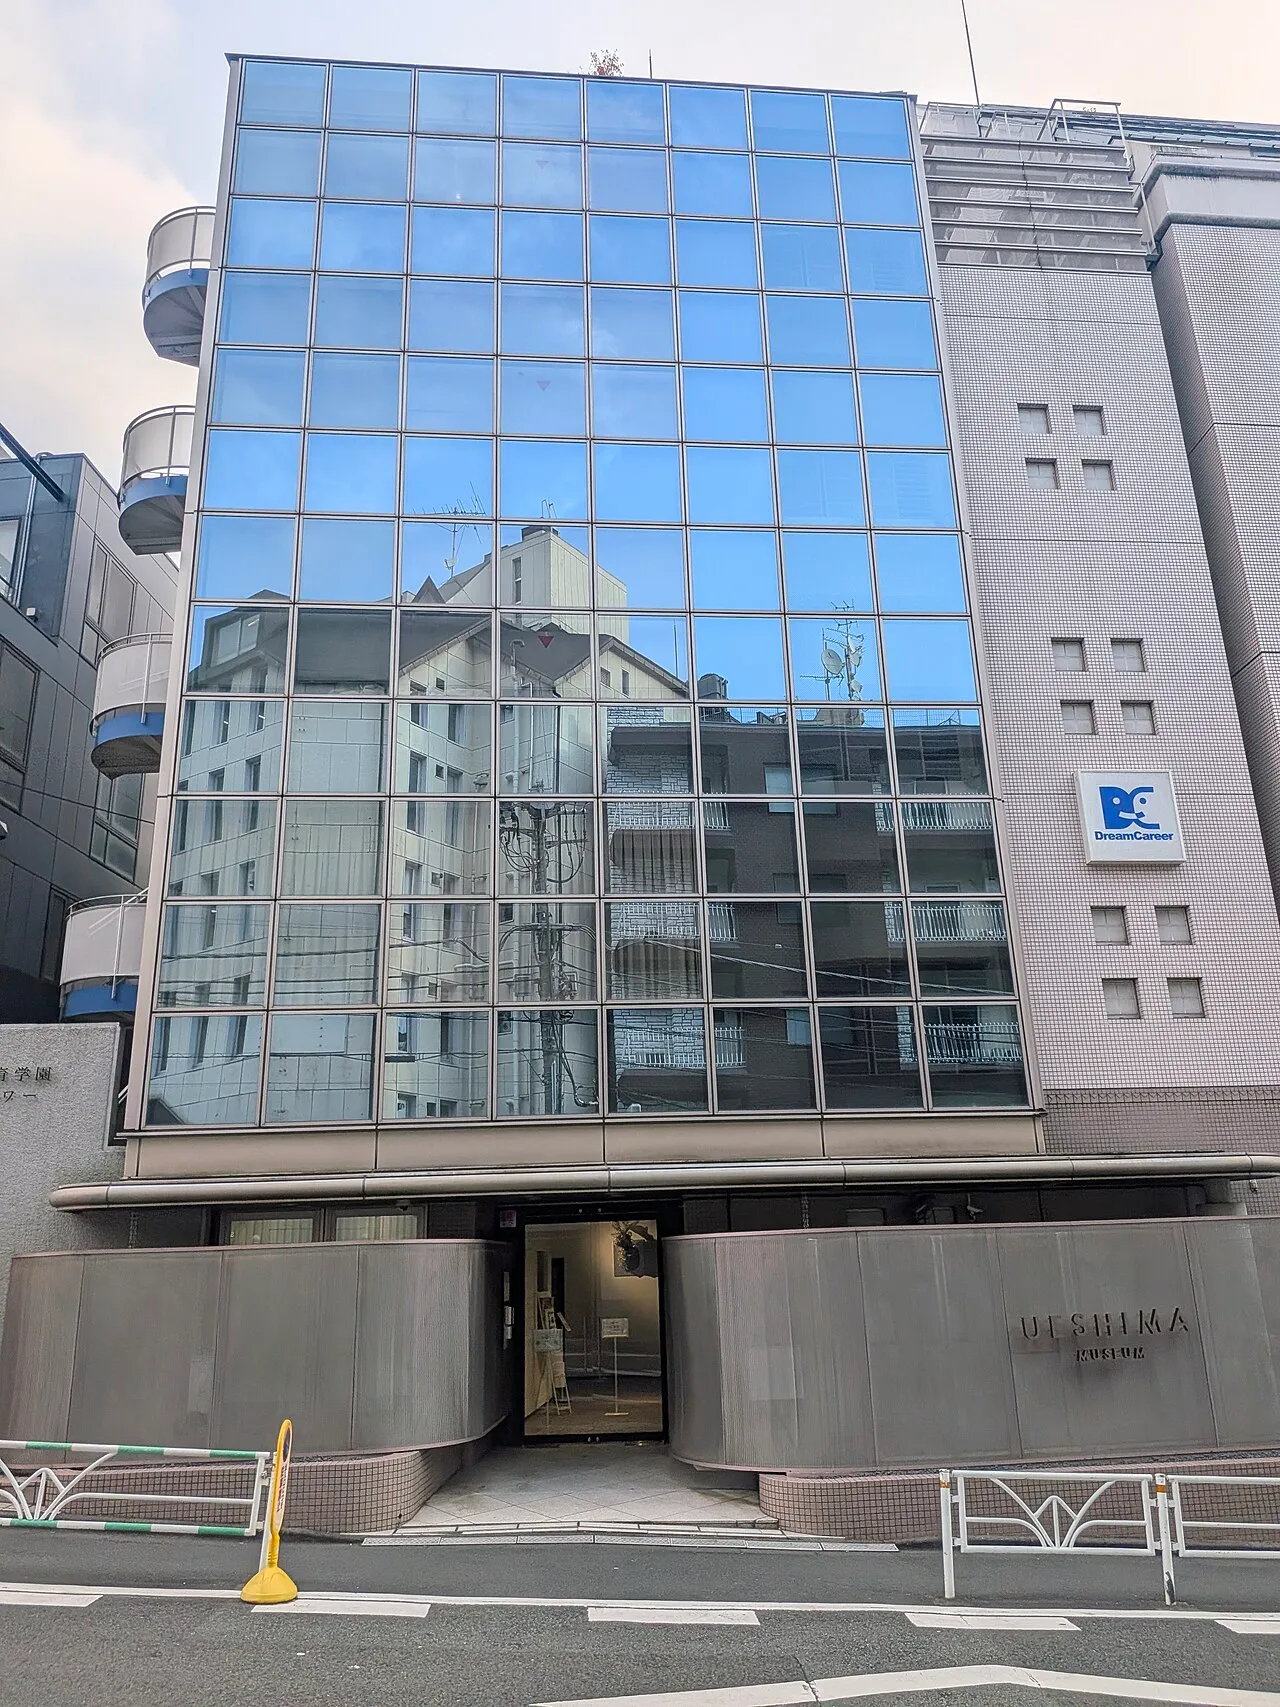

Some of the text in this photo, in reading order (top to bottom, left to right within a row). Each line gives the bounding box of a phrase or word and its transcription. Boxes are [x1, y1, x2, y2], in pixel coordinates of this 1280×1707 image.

[1094, 831, 1174, 841] DreamCareer
[1020, 1307, 1189, 1340] UESHIMA
[1076, 1347, 1145, 1362] MUSEUM
